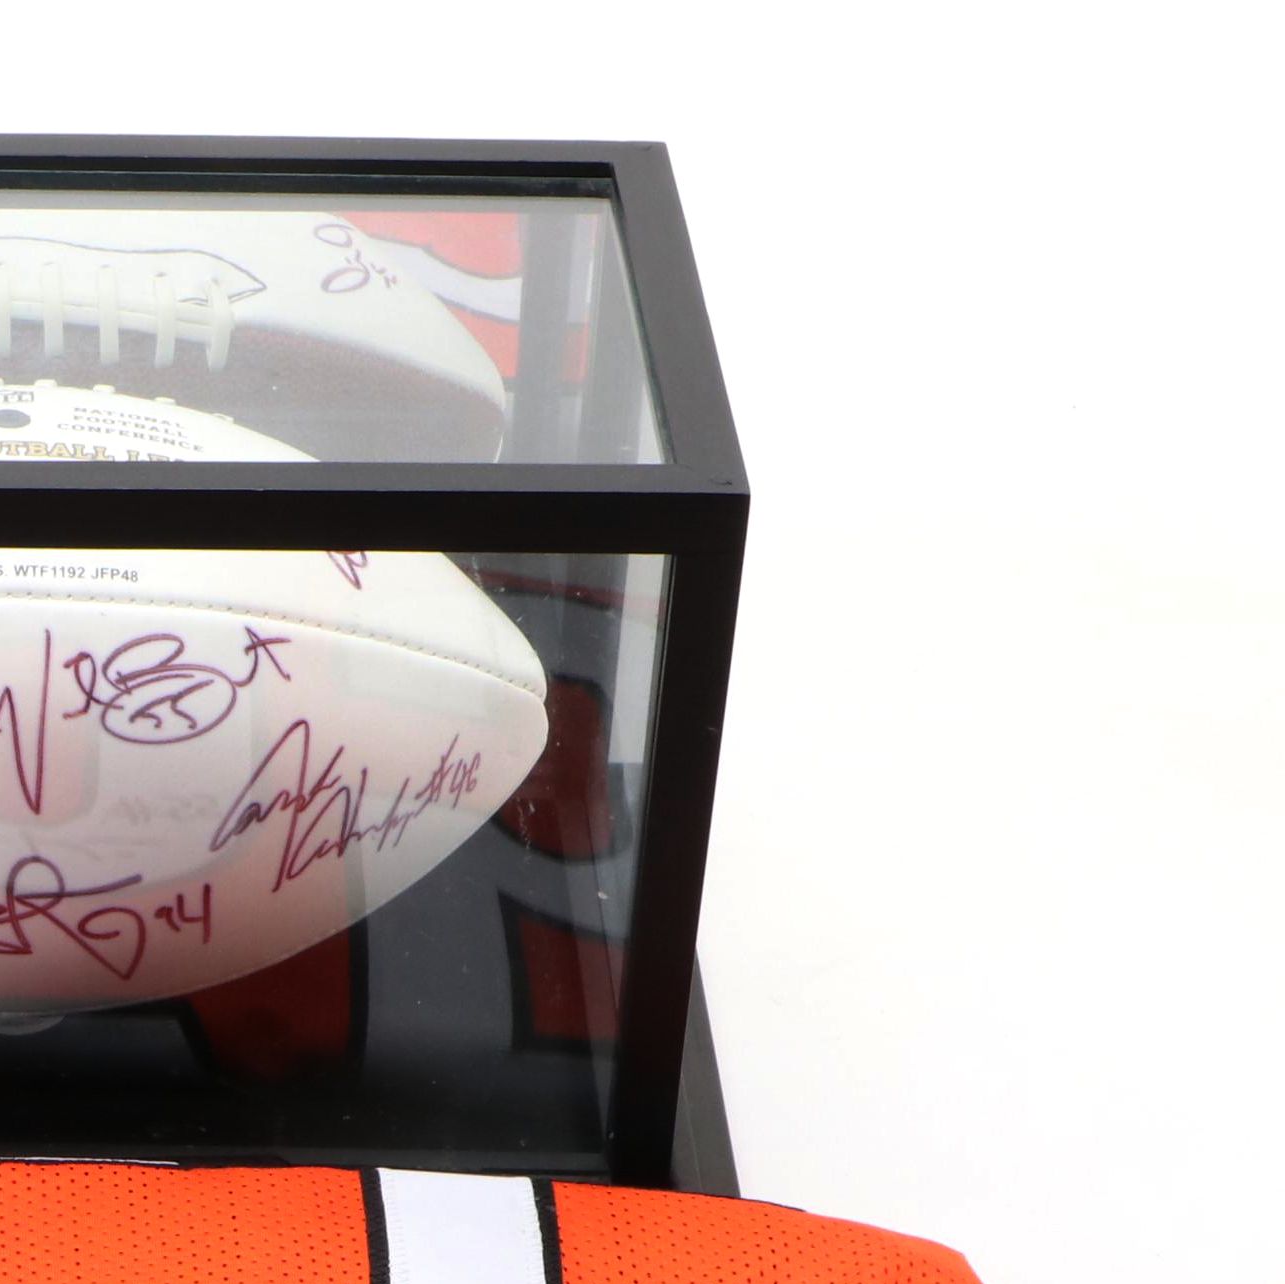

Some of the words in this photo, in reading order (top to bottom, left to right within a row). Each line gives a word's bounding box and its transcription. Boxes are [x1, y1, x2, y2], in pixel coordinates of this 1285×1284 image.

[72, 415, 188, 439] FOOTBALL
[73, 406, 187, 429] NATIONAL
[57, 422, 205, 453] CONFERENCE
[13, 564, 85, 579] WTF1192
[91, 567, 139, 583] JFP48
